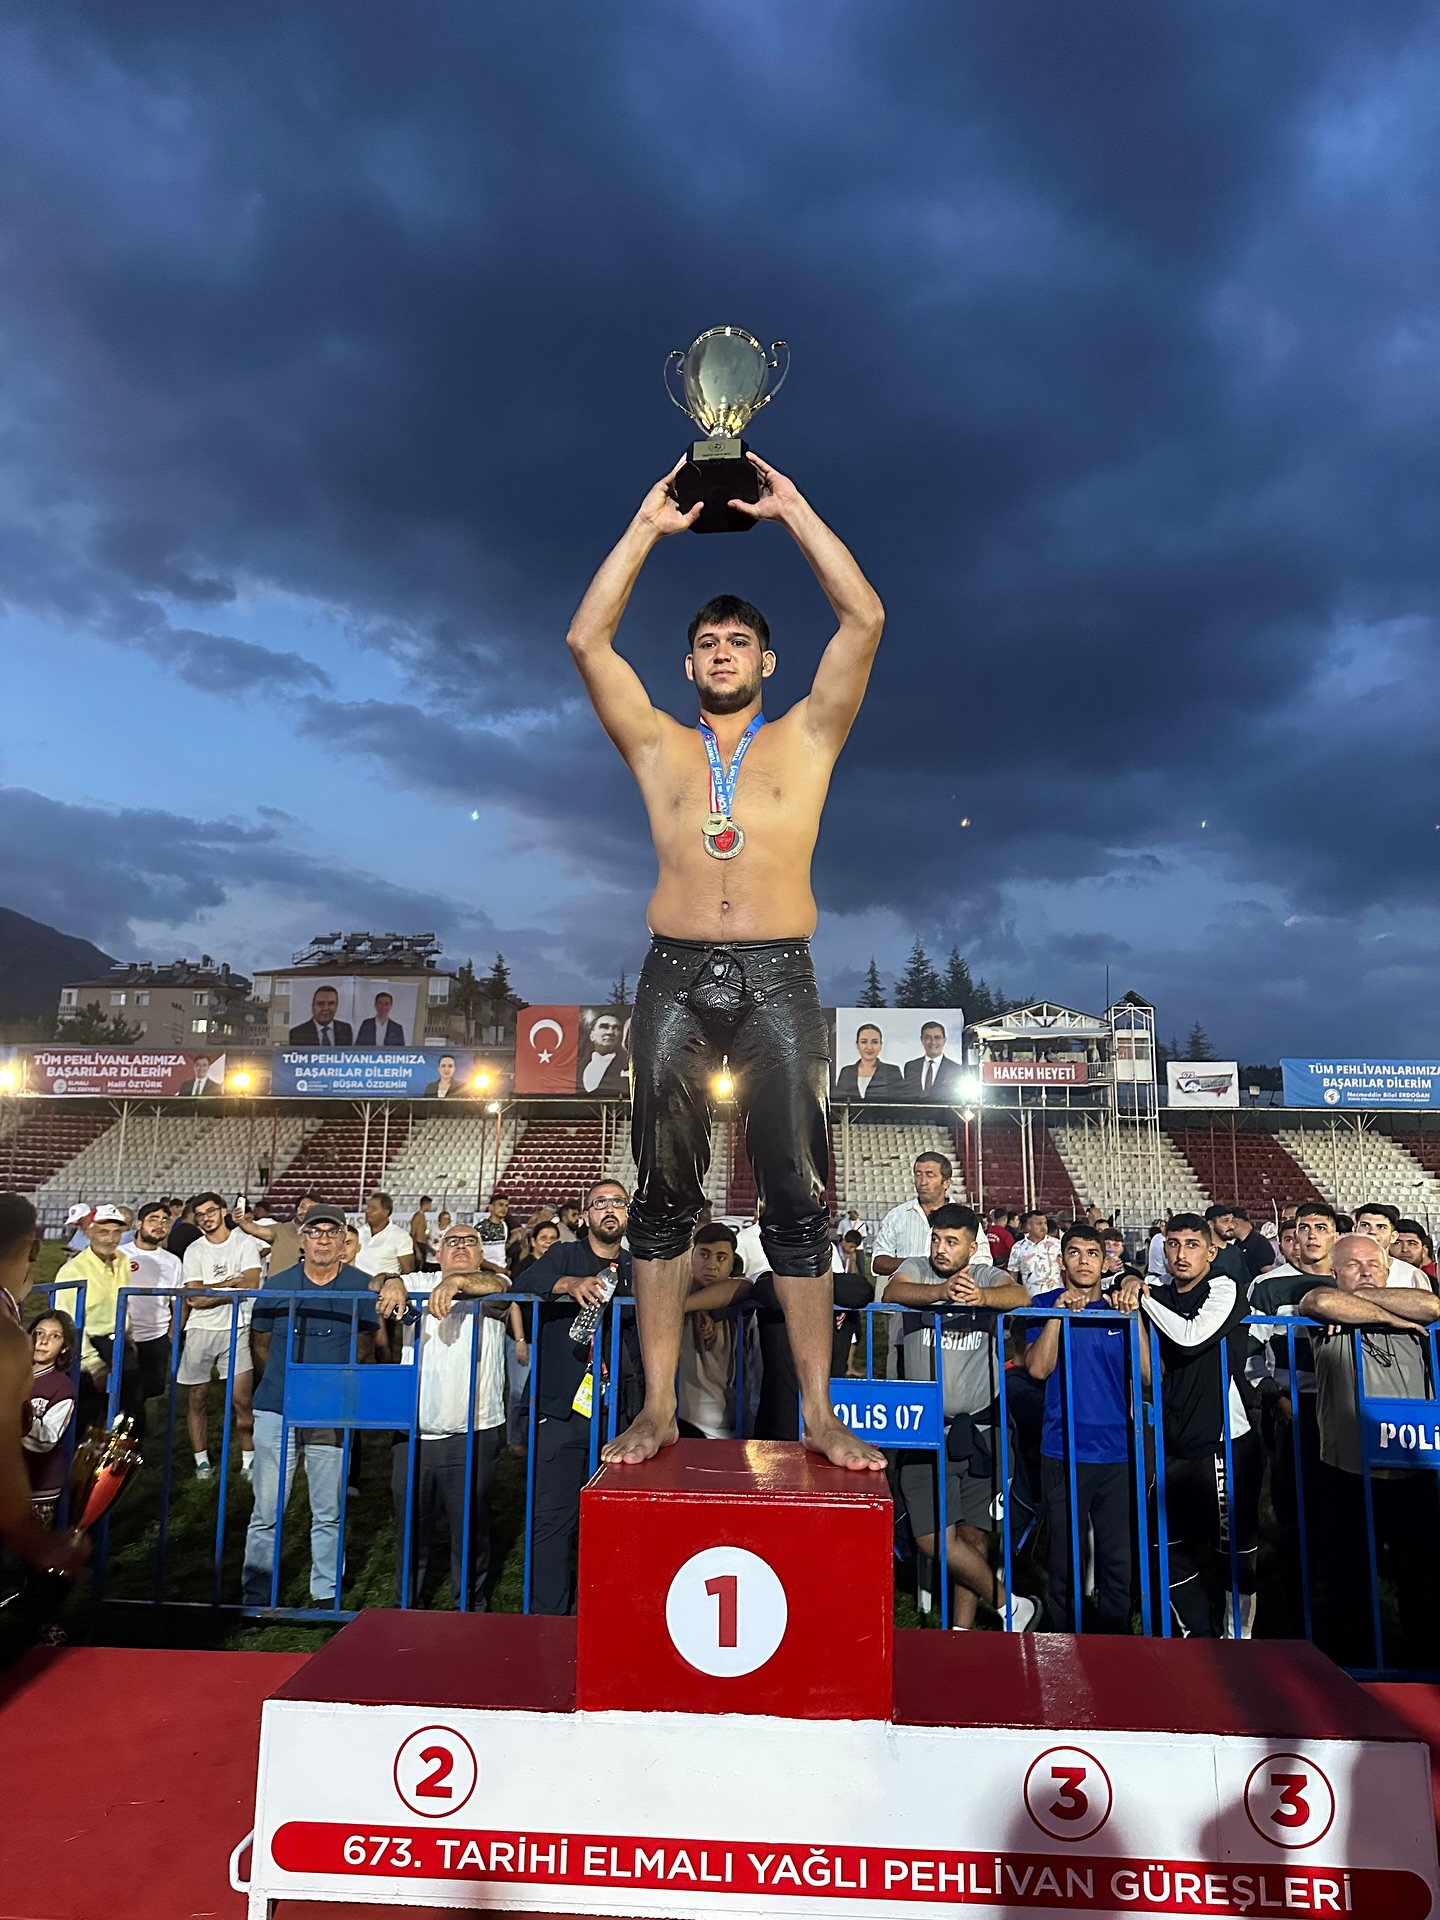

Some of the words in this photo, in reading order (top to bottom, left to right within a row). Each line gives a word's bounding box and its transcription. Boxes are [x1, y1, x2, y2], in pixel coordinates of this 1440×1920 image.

[34, 1053, 62, 1065] TÜM
[64, 1053, 186, 1065] PEHLİVANLARIMIZA
[283, 1052, 309, 1064] TÜM
[311, 1052, 426, 1064] PEHLİVANLARIMIZA
[46, 1066, 118, 1078] BAŞARILAR
[120, 1066, 172, 1078] DİLERİM
[295, 1068, 362, 1079] BAŞARILAR
[365, 1066, 412, 1078] DİLERİM
[993, 1066, 1034, 1080] HAKEM
[1036, 1065, 1076, 1080] HEYETİ
[1308, 1063, 1333, 1074] TÜM
[127, 1079, 163, 1089] ÖZTÜRK
[333, 1080, 364, 1090] BÜŞRA
[366, 1079, 407, 1089] ÖZDEMİR
[1323, 1078, 1384, 1089] BAŞARILAR
[1387, 1077, 1432, 1089] DİLERİM
[1398, 1091, 1430, 1099] ERDOĞAN
[833, 1403, 887, 1430] OLiS
[895, 1405, 924, 1431] 07
[704, 1575, 737, 1647] 1
[416, 1745, 454, 1798] 2
[1049, 1766, 1089, 1821] 3
[1270, 1773, 1310, 1828] 3
[343, 1834, 422, 1868] 673.
[436, 1836, 568, 1875] TARİHİ
[584, 1845, 733, 1883] ELMALI
[747, 1847, 867, 1889] YAĞLI
[884, 1857, 1094, 1900] PEHLİVAN
[1110, 1864, 1353, 1912] GÜREŞLERİ
